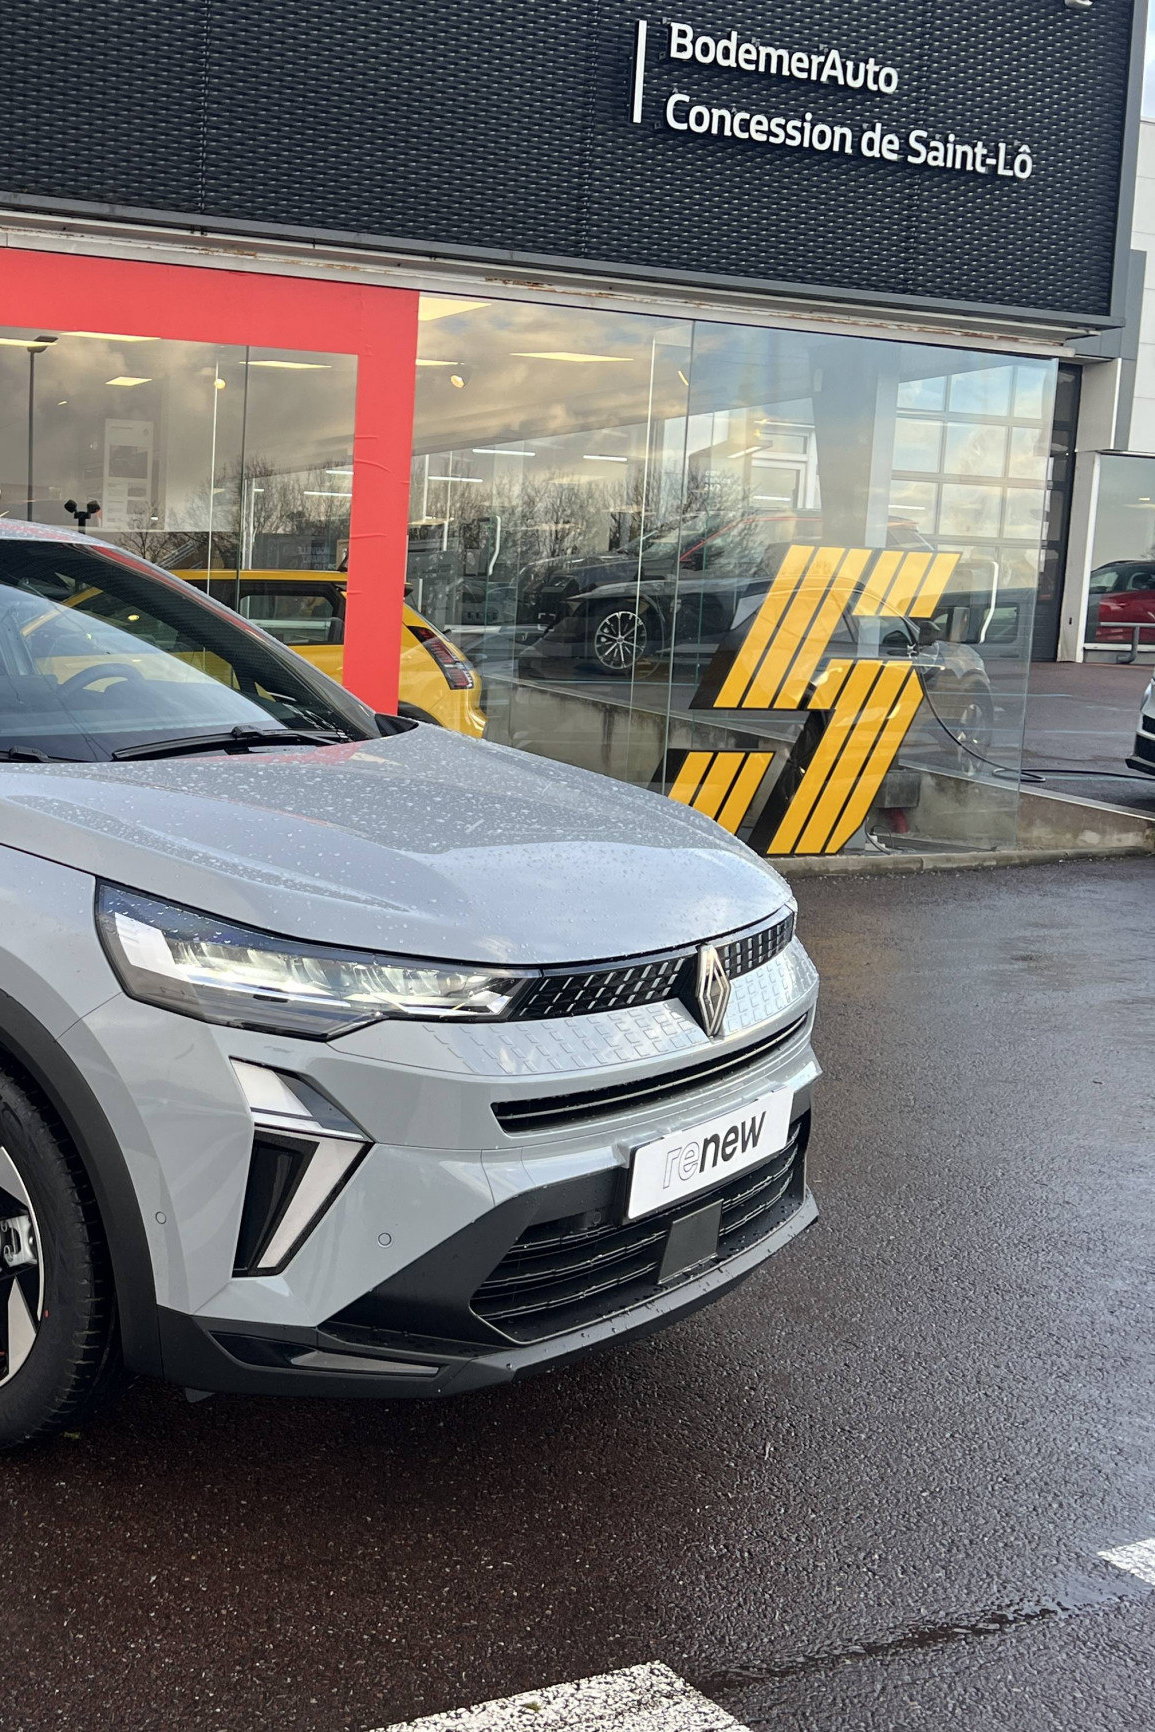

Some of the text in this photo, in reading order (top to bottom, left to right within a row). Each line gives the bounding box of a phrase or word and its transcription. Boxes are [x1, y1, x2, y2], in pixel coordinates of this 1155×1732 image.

[669, 21, 899, 94] BodemerAuto
[666, 93, 1034, 180] Concession de Saint-Lô
[662, 1110, 767, 1190] renew
